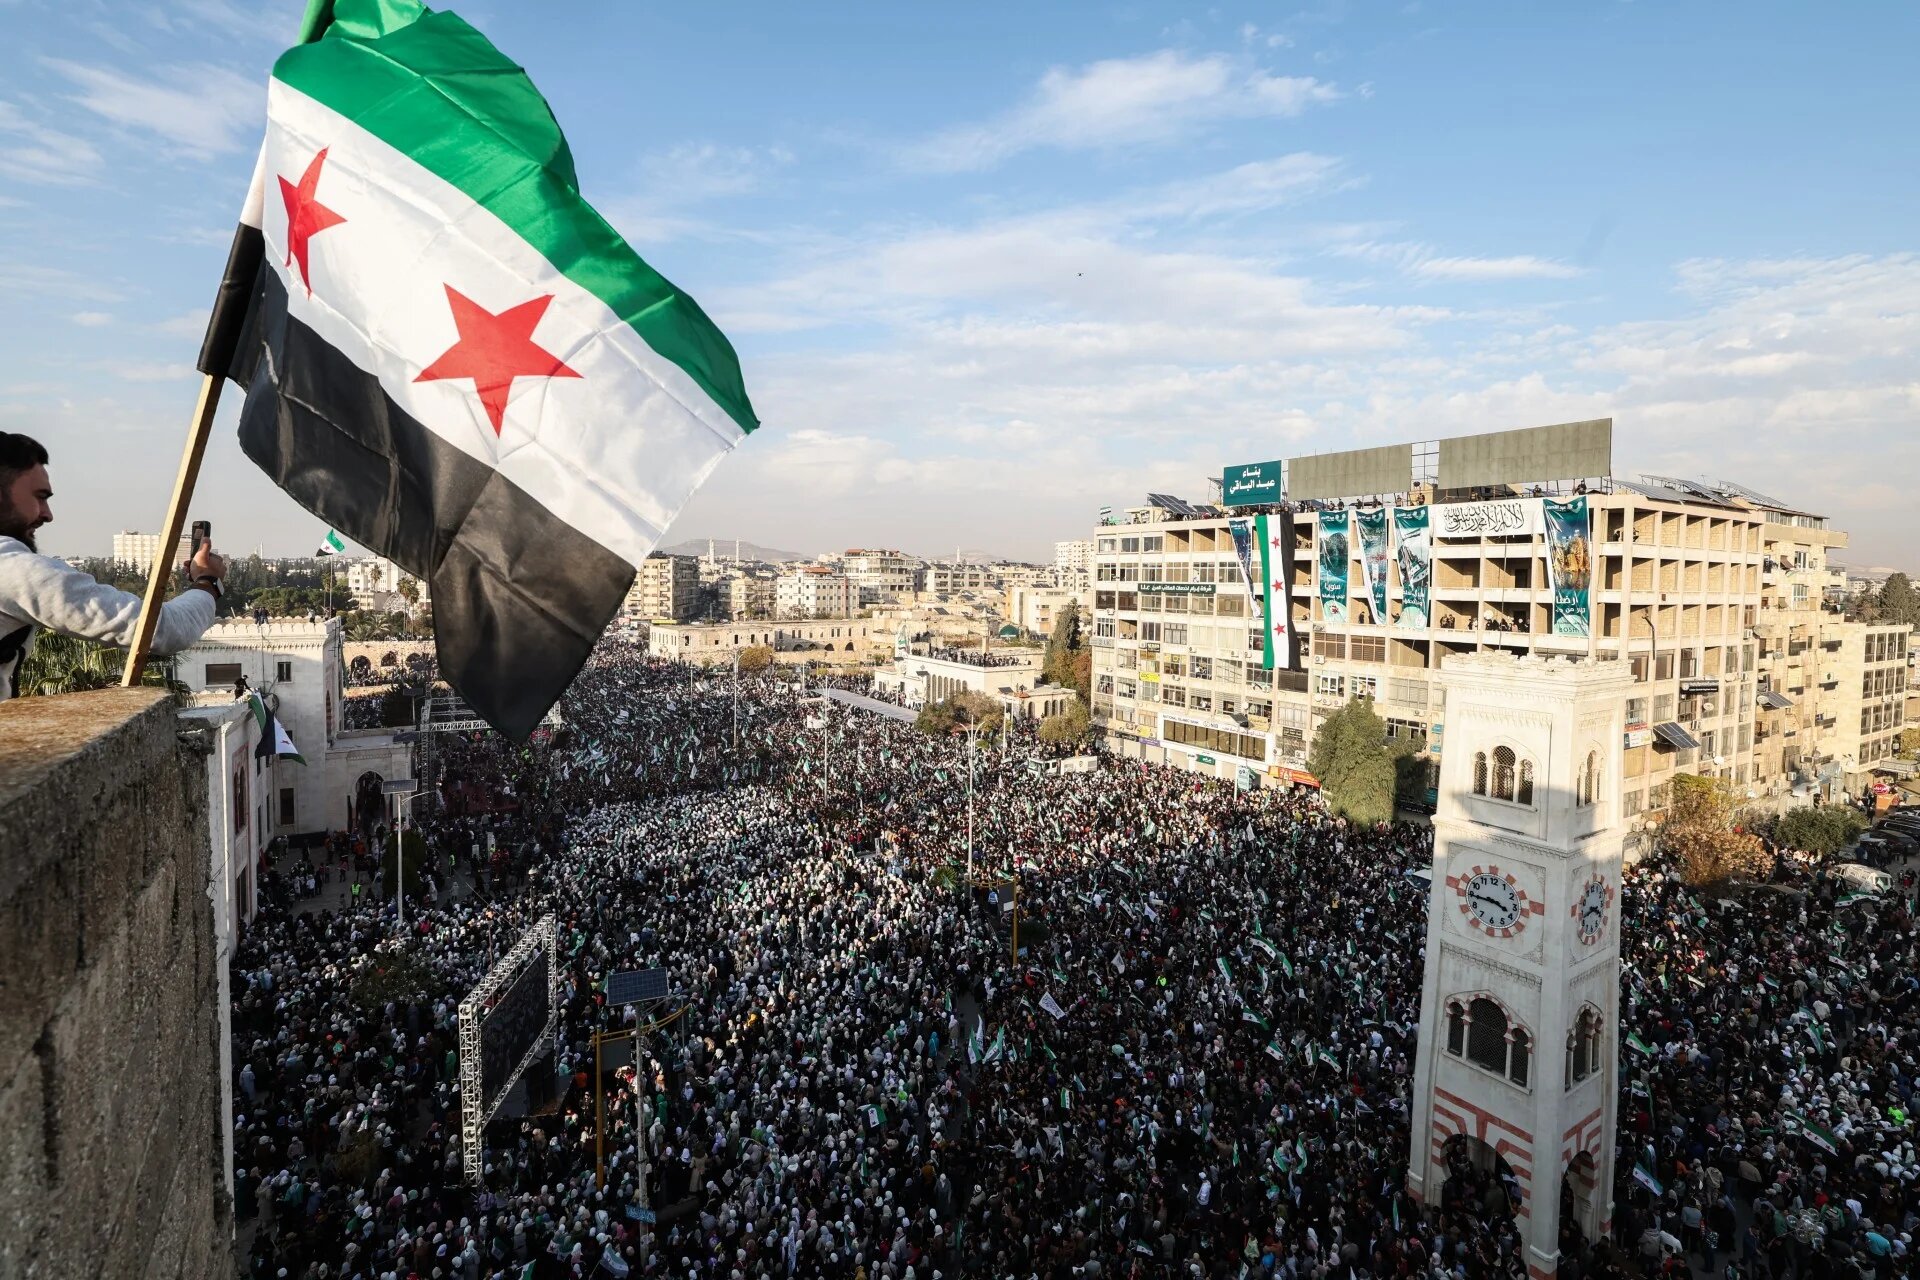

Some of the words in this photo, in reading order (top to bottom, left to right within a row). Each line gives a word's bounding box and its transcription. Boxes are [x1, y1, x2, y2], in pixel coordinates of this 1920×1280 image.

[1242, 466, 1261, 478] بناء
[1229, 479, 1255, 495] الباقي
[1256, 479, 1275, 490] عبد
[1480, 877, 1488, 886] 11
[1490, 877, 1499, 886] 12
